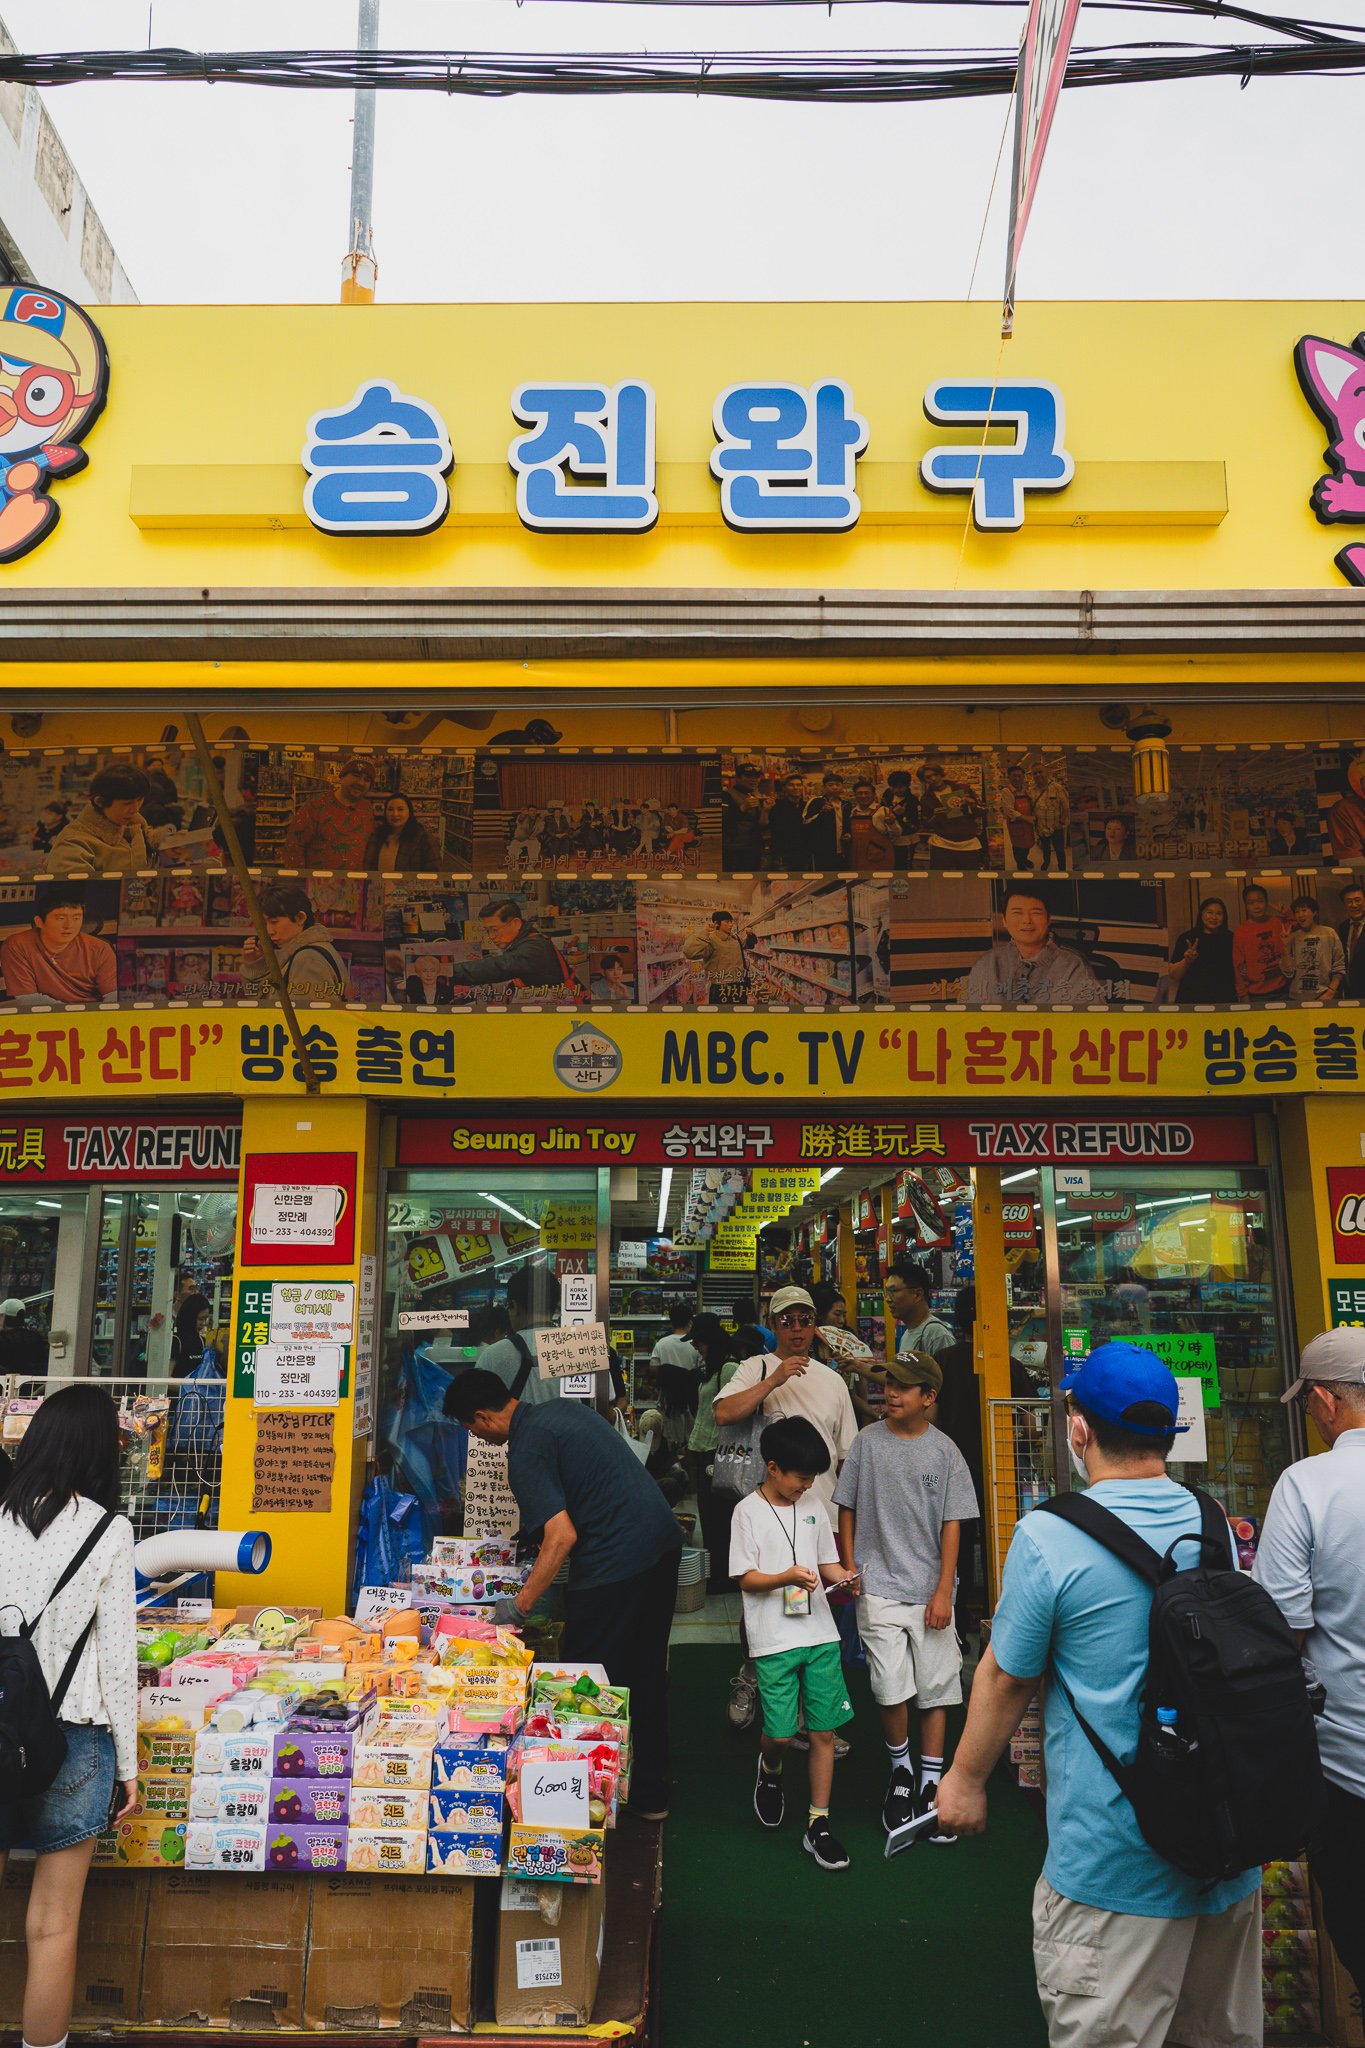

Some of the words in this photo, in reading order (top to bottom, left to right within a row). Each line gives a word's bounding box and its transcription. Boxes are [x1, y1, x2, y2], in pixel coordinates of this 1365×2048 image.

[302, 377, 1076, 536] 승진완구
[571, 1039, 589, 1053] 나
[240, 1024, 339, 1084] 방송
[355, 1025, 456, 1087] 출연
[661, 1029, 784, 1086] MBC.
[798, 1029, 865, 1086] TV
[964, 1026, 1057, 1086] 혼자
[1204, 1024, 1299, 1086] 방송
[1313, 1023, 1365, 1082] 출
[569, 1055, 595, 1068] 혼자
[575, 1070, 602, 1083] 산다
[452, 1128, 535, 1157] Seung
[540, 1128, 582, 1152] Jin
[587, 1128, 637, 1157] Toy
[662, 1124, 774, 1158] 승진완구
[801, 1123, 945, 1159] 勝進玩具
[969, 1123, 1048, 1157] TAX
[1053, 1122, 1194, 1158] REFUND
[64, 1125, 131, 1170] TAX
[760, 1177, 777, 1189] 방송
[779, 1177, 797, 1189] 촬영
[798, 1177, 815, 1189] 장소
[1064, 1176, 1084, 1185] VISA
[273, 1195, 313, 1206] 신한은행
[750, 1192, 765, 1203] 방송
[784, 1192, 799, 1203] 장소
[277, 1211, 308, 1223] 정만례
[445, 1209, 498, 1220] 감시카메라
[1002, 1203, 1031, 1222] EGO
[254, 1227, 268, 1236] 110
[276, 1228, 292, 1236] 233
[299, 1228, 333, 1237] 404392
[558, 1258, 584, 1274] TAX
[281, 1288, 302, 1302] 현금
[570, 1293, 588, 1301] TAX
[294, 1303, 332, 1316] 여기서!
[242, 1321, 268, 1345] 2층
[275, 1355, 316, 1367] 신한은행
[280, 1373, 311, 1385] 정만례
[569, 1375, 587, 1383] TAX
[257, 1389, 270, 1398] 110
[279, 1389, 294, 1398] 233
[304, 1389, 337, 1398] 404392
[263, 1413, 300, 1429] 사장님
[479, 1450, 501, 1460] 말랑이
[922, 1473, 939, 1484] YALE
[473, 1481, 488, 1491] 그냥
[366, 1587, 387, 1601] 대왕
[389, 1591, 406, 1604] 만두
[179, 1674, 210, 1686] 4500
[149, 1693, 182, 1706] 5500
[172, 1742, 191, 1755] 망고
[243, 1747, 269, 1758] 크런치
[313, 1745, 341, 1755] 망고스틴
[229, 1758, 262, 1772] 슬랑이
[319, 1755, 343, 1764] 크런치
[318, 1764, 344, 1775] 슬랑이
[386, 1761, 408, 1775] 치즈
[472, 1764, 488, 1775] 치즈
[167, 1786, 186, 1799] 망고
[570, 1776, 585, 1800] 원
[238, 1792, 265, 1804] 크런치
[310, 1790, 338, 1801] 망고스틴
[224, 1803, 258, 1817] 슬랑이
[315, 1801, 340, 1810] 크런치
[383, 1803, 405, 1817] 치즈
[468, 1806, 484, 1817] 치즈
[314, 1810, 341, 1821] 슬랑이
[234, 1839, 260, 1850] 크런치
[306, 1837, 335, 1848] 망고스틴
[220, 1849, 254, 1863] 슬랑이
[312, 1847, 337, 1857] 크런치
[380, 1845, 402, 1859] 치즈
[467, 1848, 483, 1859] 치즈
[512, 1844, 567, 1866] 랜덤만두
[312, 1856, 338, 1868] 슬랑이
[525, 1859, 555, 1874] 말랑이
[342, 1878, 371, 1887] SAMG
[534, 1972, 560, 1981] 6527518
